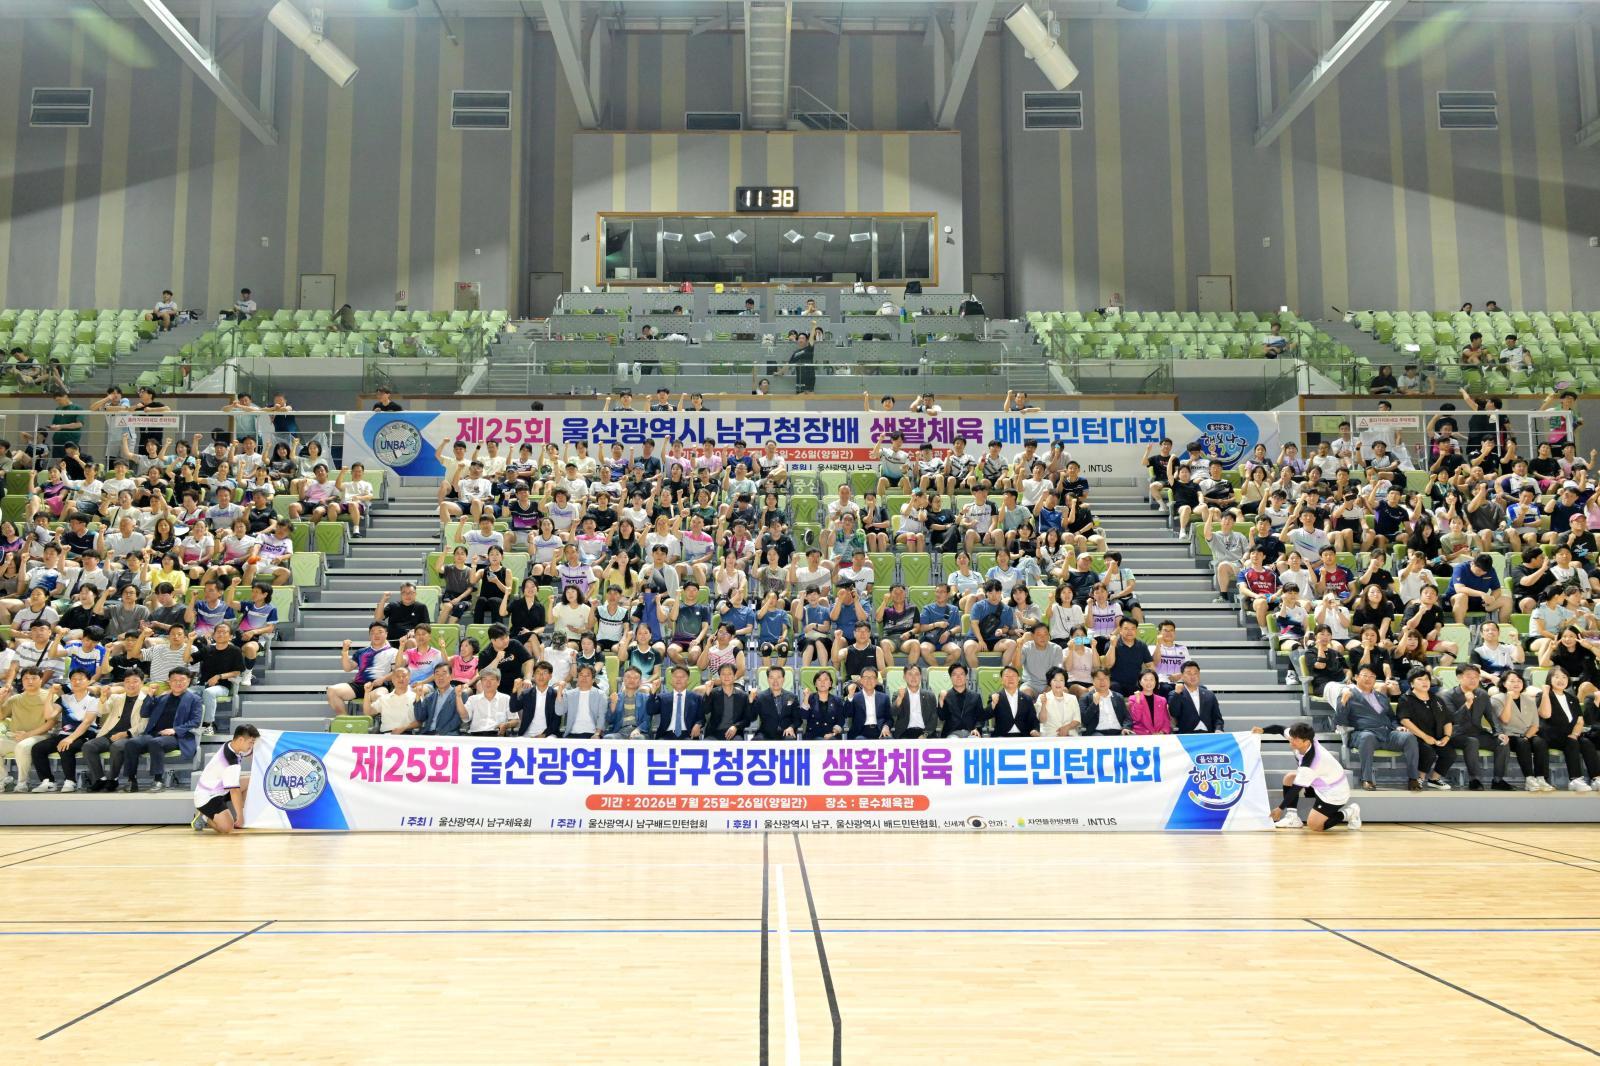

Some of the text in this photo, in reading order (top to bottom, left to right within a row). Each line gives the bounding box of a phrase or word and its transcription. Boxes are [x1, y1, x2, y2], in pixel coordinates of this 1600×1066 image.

[771, 189, 794, 208] 38
[456, 417, 1166, 445] 제25회 울산광역시 남구청장배 생활체육 배드민턴대회
[380, 440, 406, 450] UNBA
[1088, 464, 1113, 472] INTUS
[350, 745, 459, 785] 제25회
[471, 747, 635, 786] 울산광역시
[647, 748, 811, 786] 남구청장배
[822, 748, 953, 786] 생활체육
[964, 746, 1162, 785] 배드민턴대회
[1200, 756, 1225, 764] 울산중심
[273, 774, 305, 788] UNBA
[1188, 766, 1250, 799] 행복남구
[601, 797, 623, 808] 기간
[634, 797, 677, 809] 2026년
[681, 797, 699, 808] 7월
[703, 797, 808, 809] 25일~26일(양일간)
[825, 797, 848, 808] 장소
[858, 797, 915, 809] 문수체육관
[407, 816, 532, 828] 주최 울산광역시 남구체육회
[556, 818, 708, 829] 주관 울산광역시 남구배드민턴협회
[733, 819, 752, 829] 후원
[764, 819, 809, 829] 울산광역시
[836, 819, 881, 829] 울산광역시
[943, 820, 966, 828] 신세계
[1087, 817, 1118, 826] INTUS
